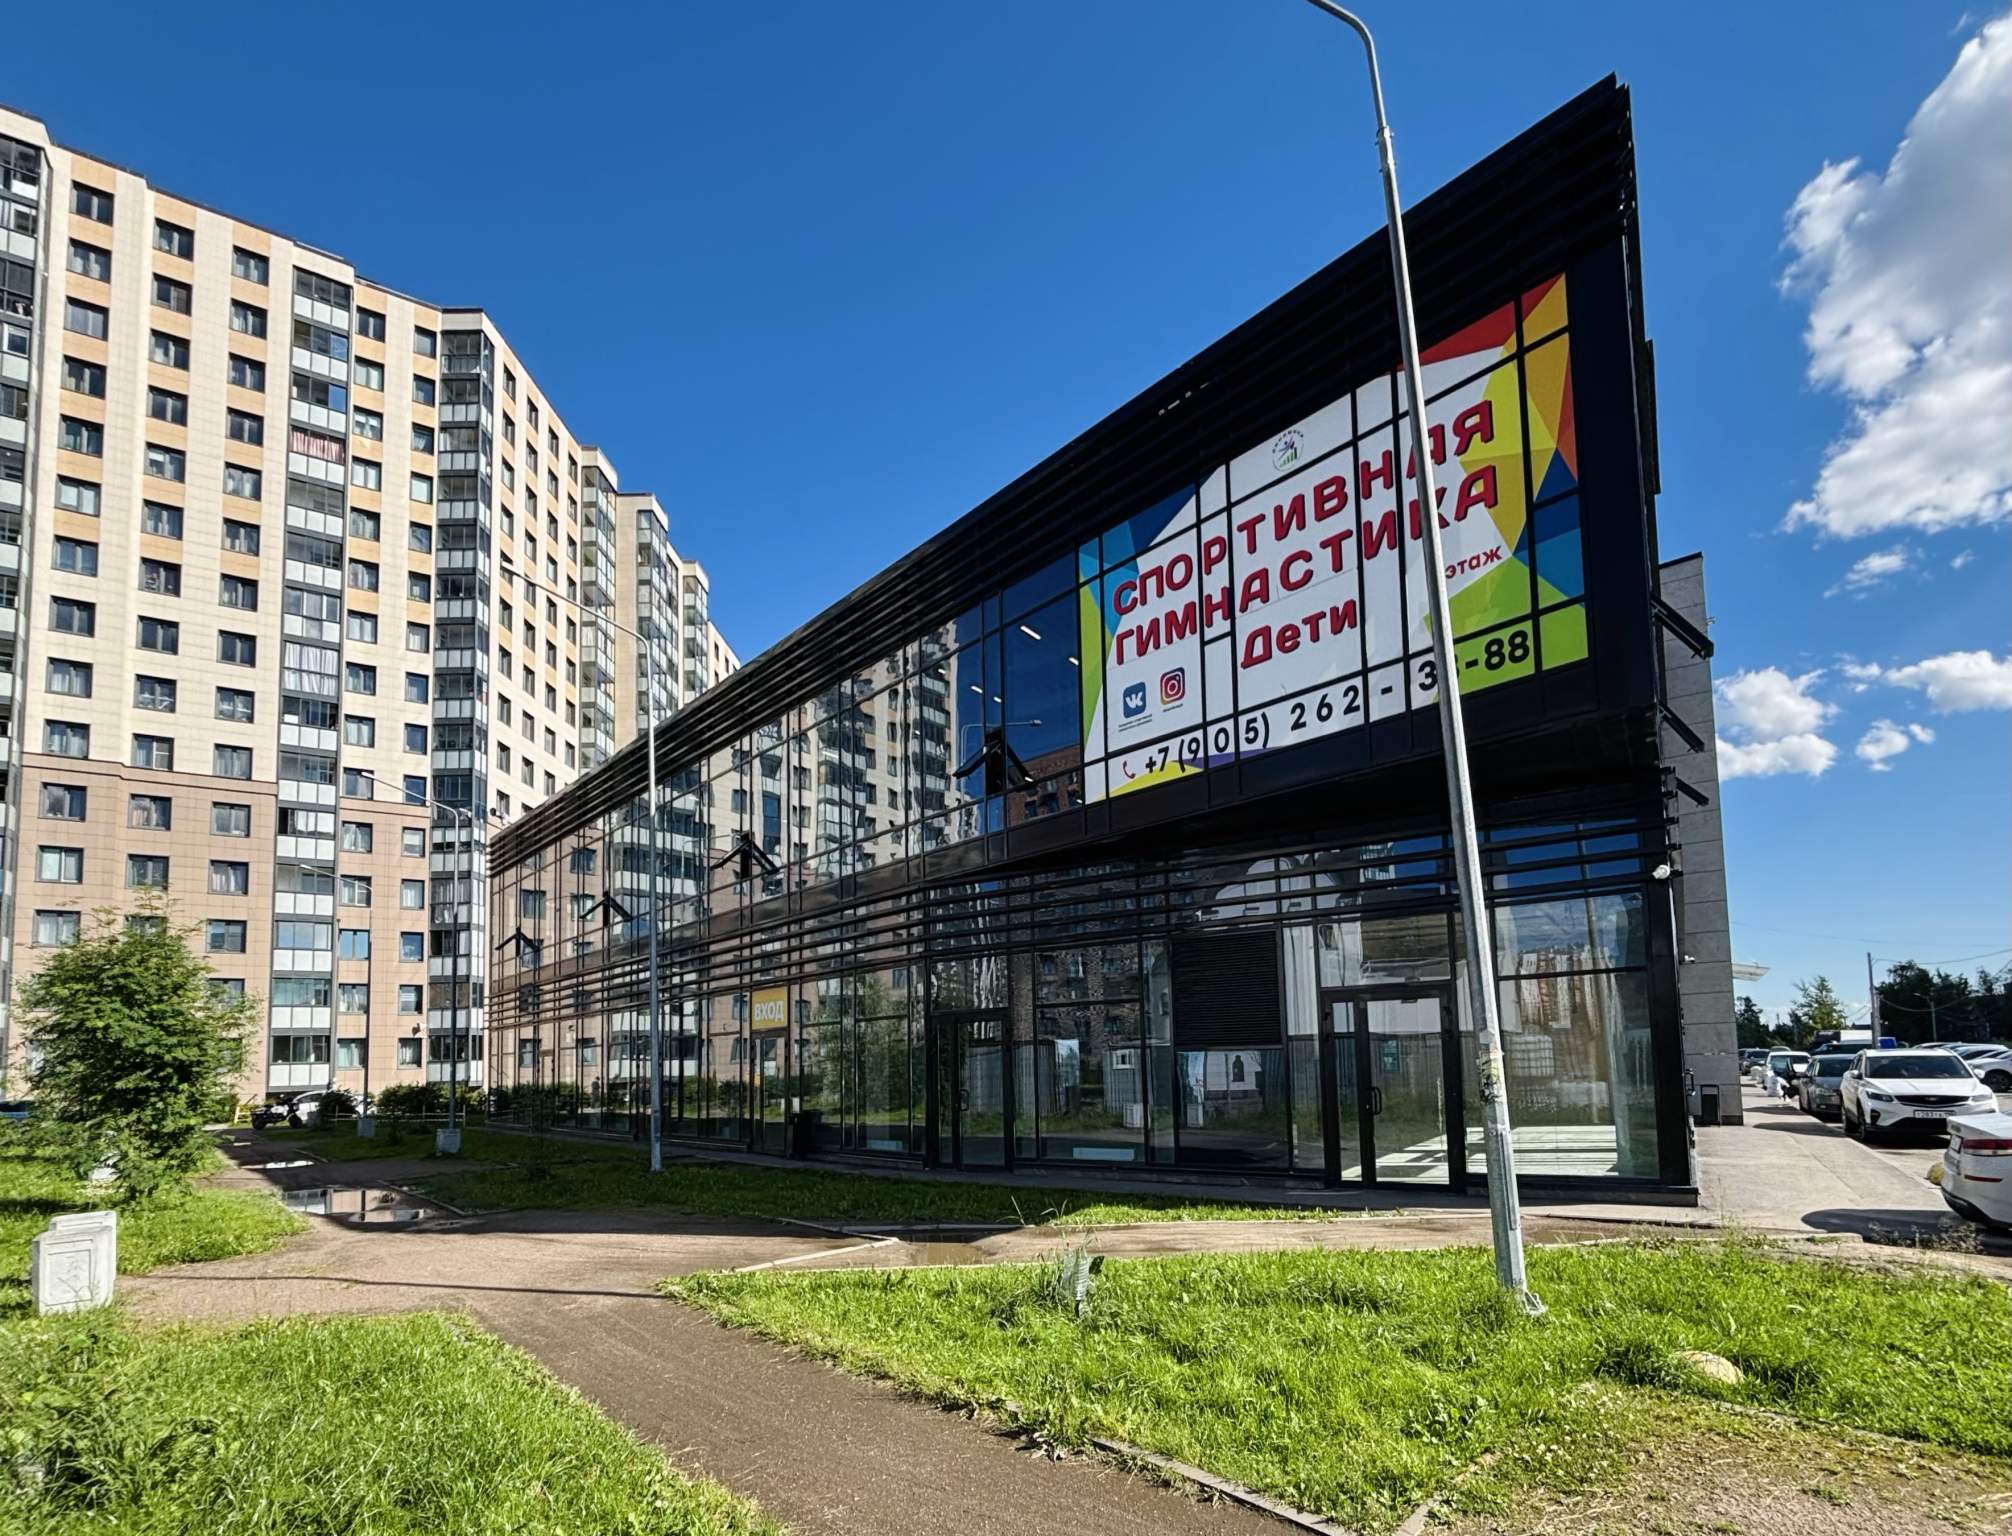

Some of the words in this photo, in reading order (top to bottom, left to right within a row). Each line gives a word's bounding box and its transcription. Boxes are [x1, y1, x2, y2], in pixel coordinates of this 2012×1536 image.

[1113, 399, 1494, 616] СПОРТИВНАЯ
[1116, 464, 1498, 666] ГИМНАСТИКА
[1444, 545, 1502, 580] этаж
[1240, 598, 1358, 670] Дети
[1290, 629, 1530, 732] 262-3-88
[754, 1000, 785, 1022] ВХОД
